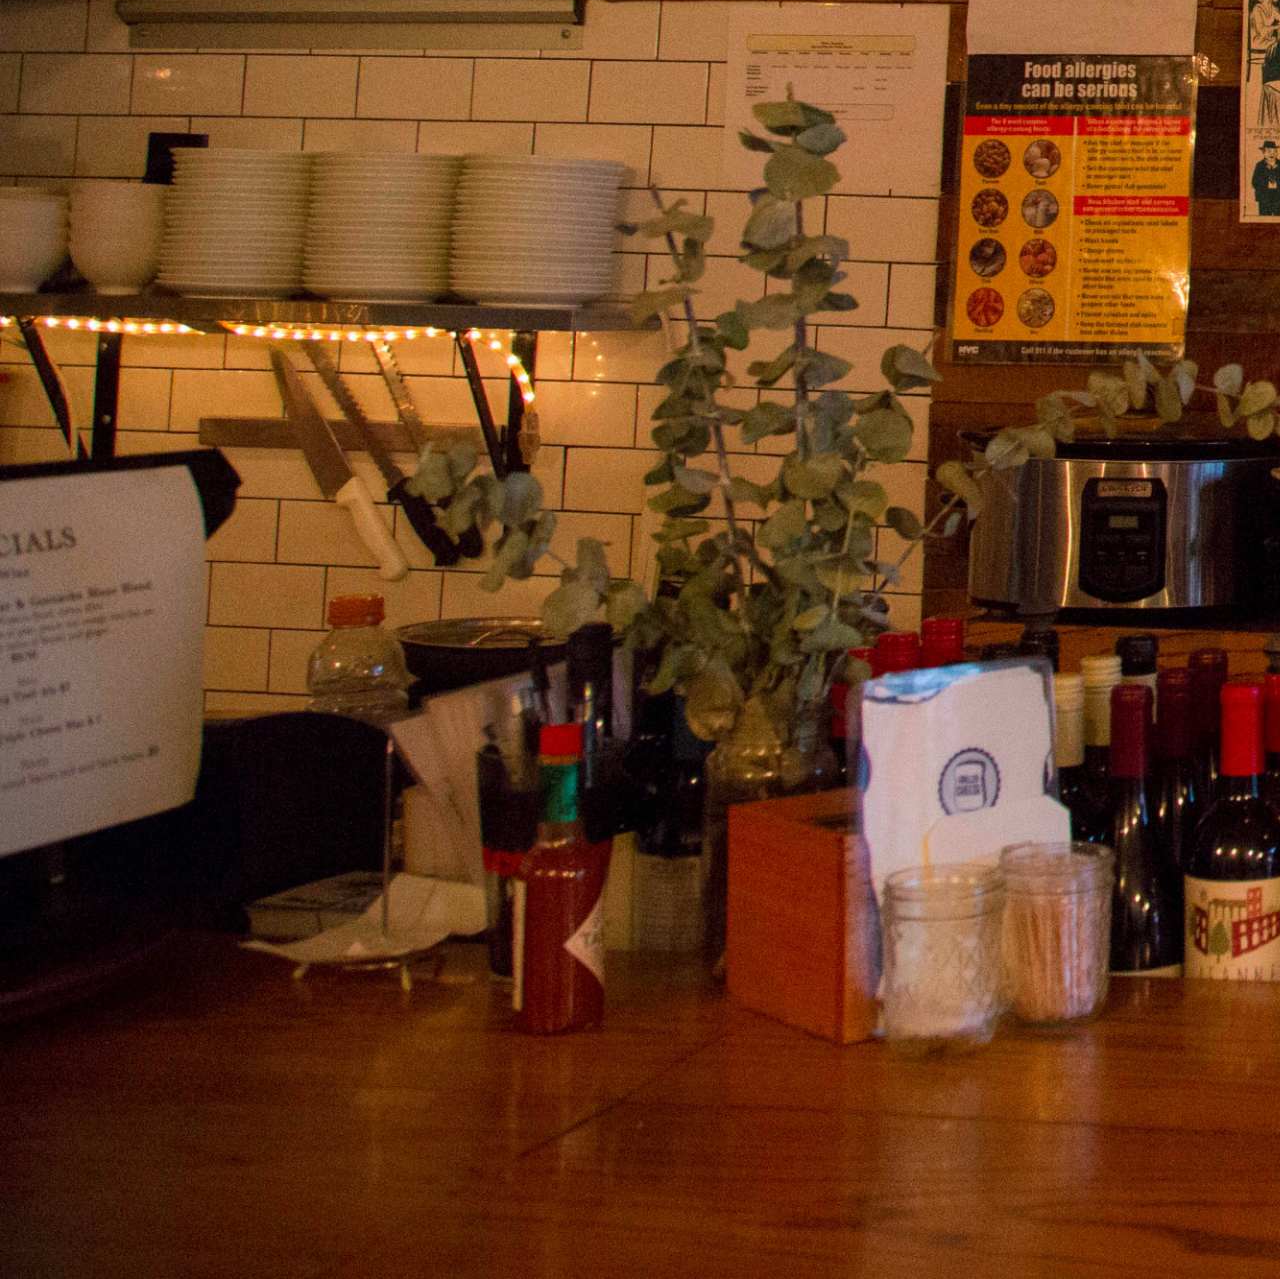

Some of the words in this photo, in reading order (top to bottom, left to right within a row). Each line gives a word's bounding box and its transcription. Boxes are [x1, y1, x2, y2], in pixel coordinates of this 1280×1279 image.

[1024, 61, 1062, 78] Food
[1065, 61, 1136, 80] allergies
[1022, 83, 1051, 98] can
[1055, 81, 1075, 98] be
[1077, 81, 1138, 98] serious
